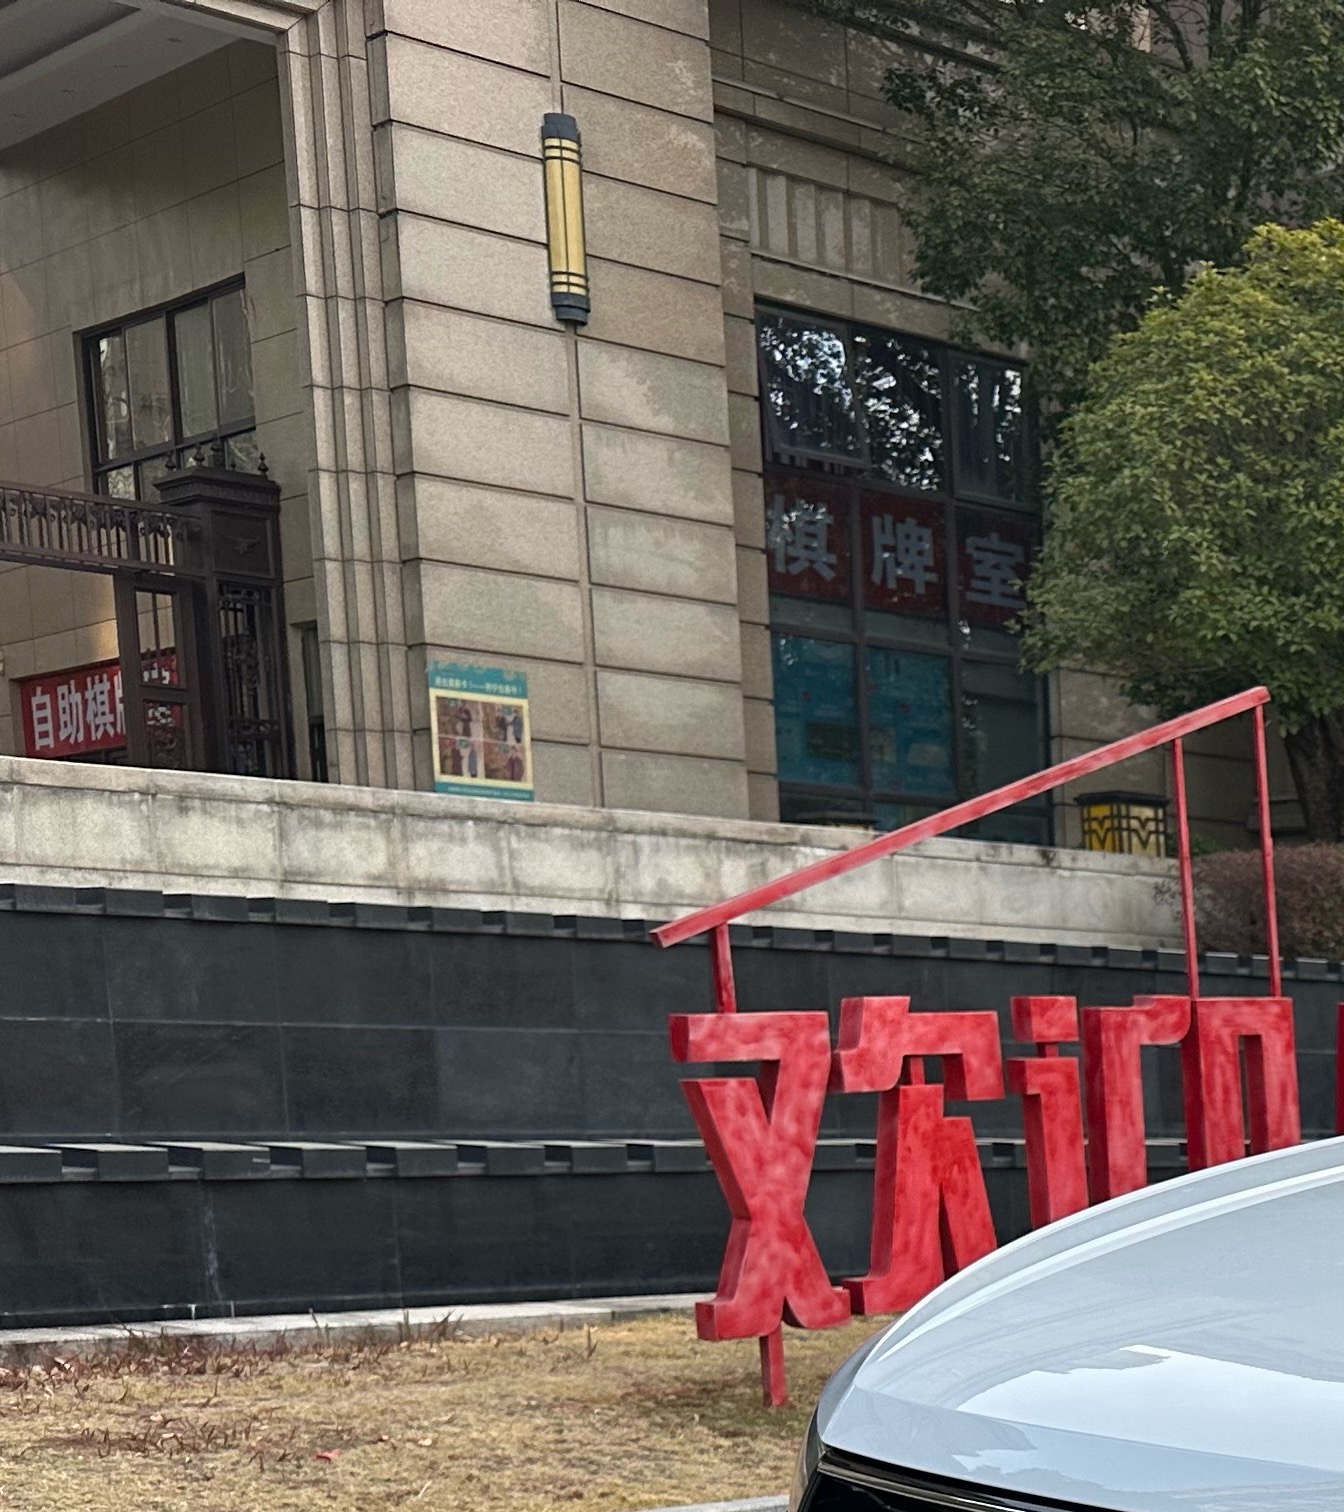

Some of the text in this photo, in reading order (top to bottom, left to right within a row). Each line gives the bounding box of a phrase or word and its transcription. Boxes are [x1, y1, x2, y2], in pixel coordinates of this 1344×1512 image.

[767, 494, 1027, 609] 棋牌室
[31, 662, 171, 751] 自助棋
